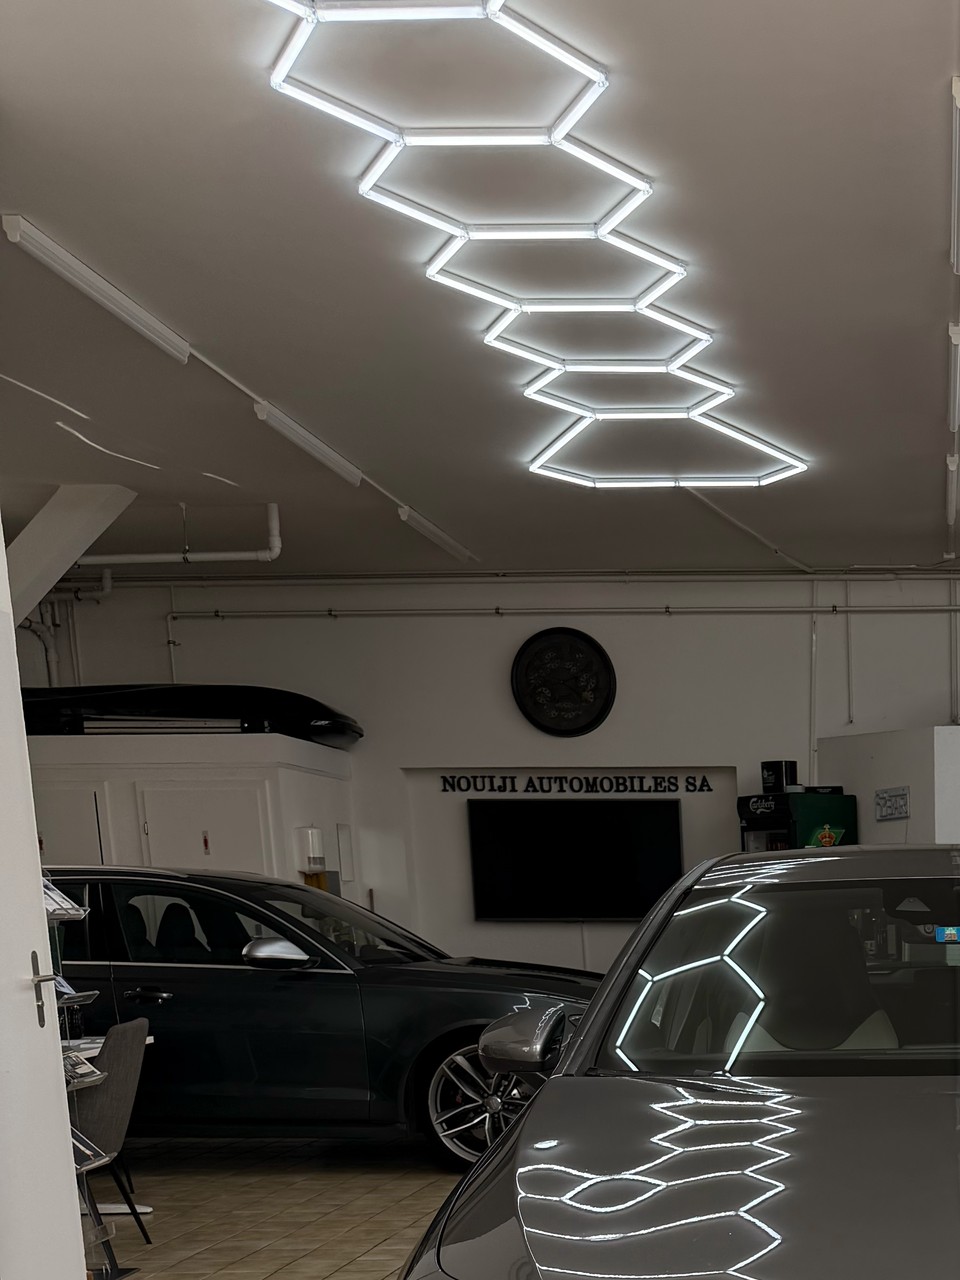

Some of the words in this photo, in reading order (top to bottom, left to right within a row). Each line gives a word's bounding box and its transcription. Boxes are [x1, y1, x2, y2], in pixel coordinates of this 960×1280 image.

[441, 775, 518, 793] NOUIJI
[523, 775, 680, 793] AUTOMOBILES
[684, 775, 713, 793] SA
[749, 796, 775, 814] Carlsberg
